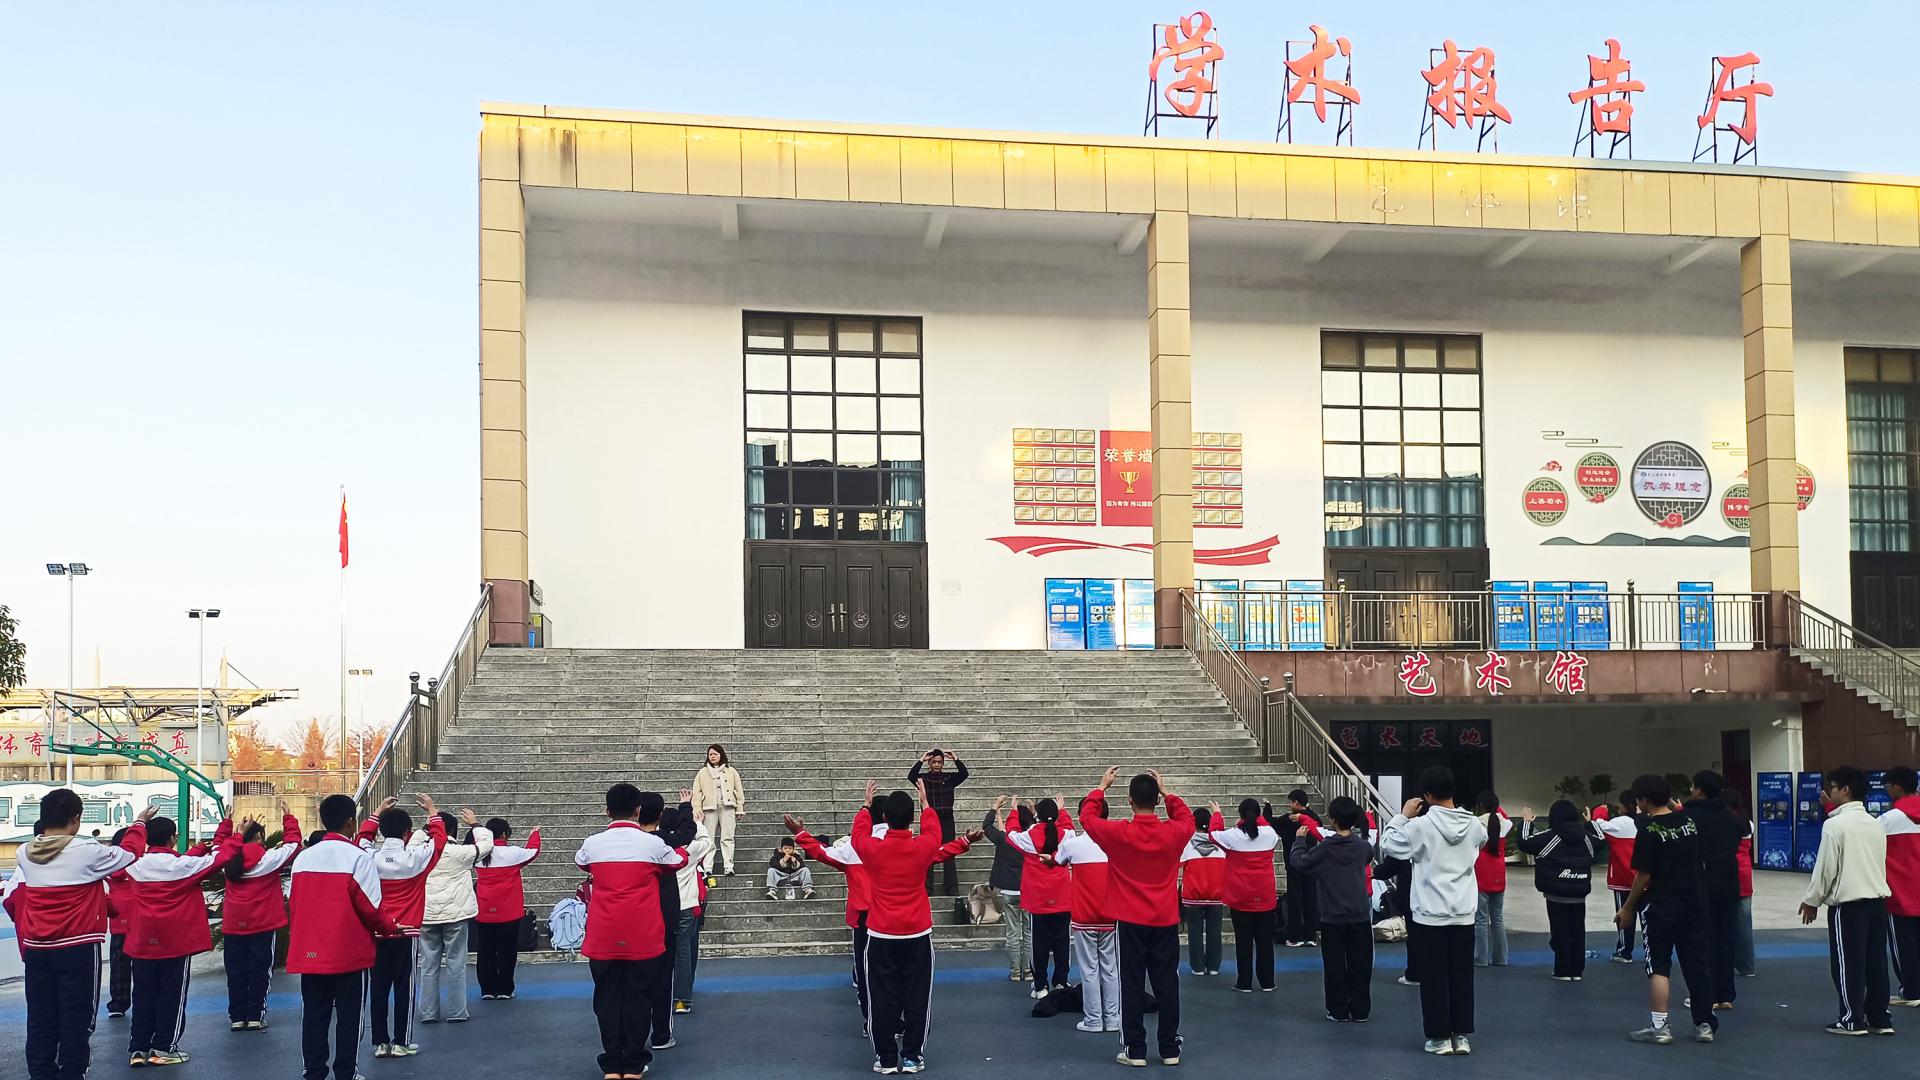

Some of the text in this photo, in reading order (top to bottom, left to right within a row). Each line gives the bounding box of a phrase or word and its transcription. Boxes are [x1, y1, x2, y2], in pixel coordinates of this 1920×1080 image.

[1149, 11, 1774, 145] 学术报告厅
[1104, 448, 1152, 463] 荣誉墙
[1643, 481, 1702, 492] 办学理念
[1398, 651, 1589, 696] 艺术馆
[1340, 726, 1488, 750] 艺术天地
